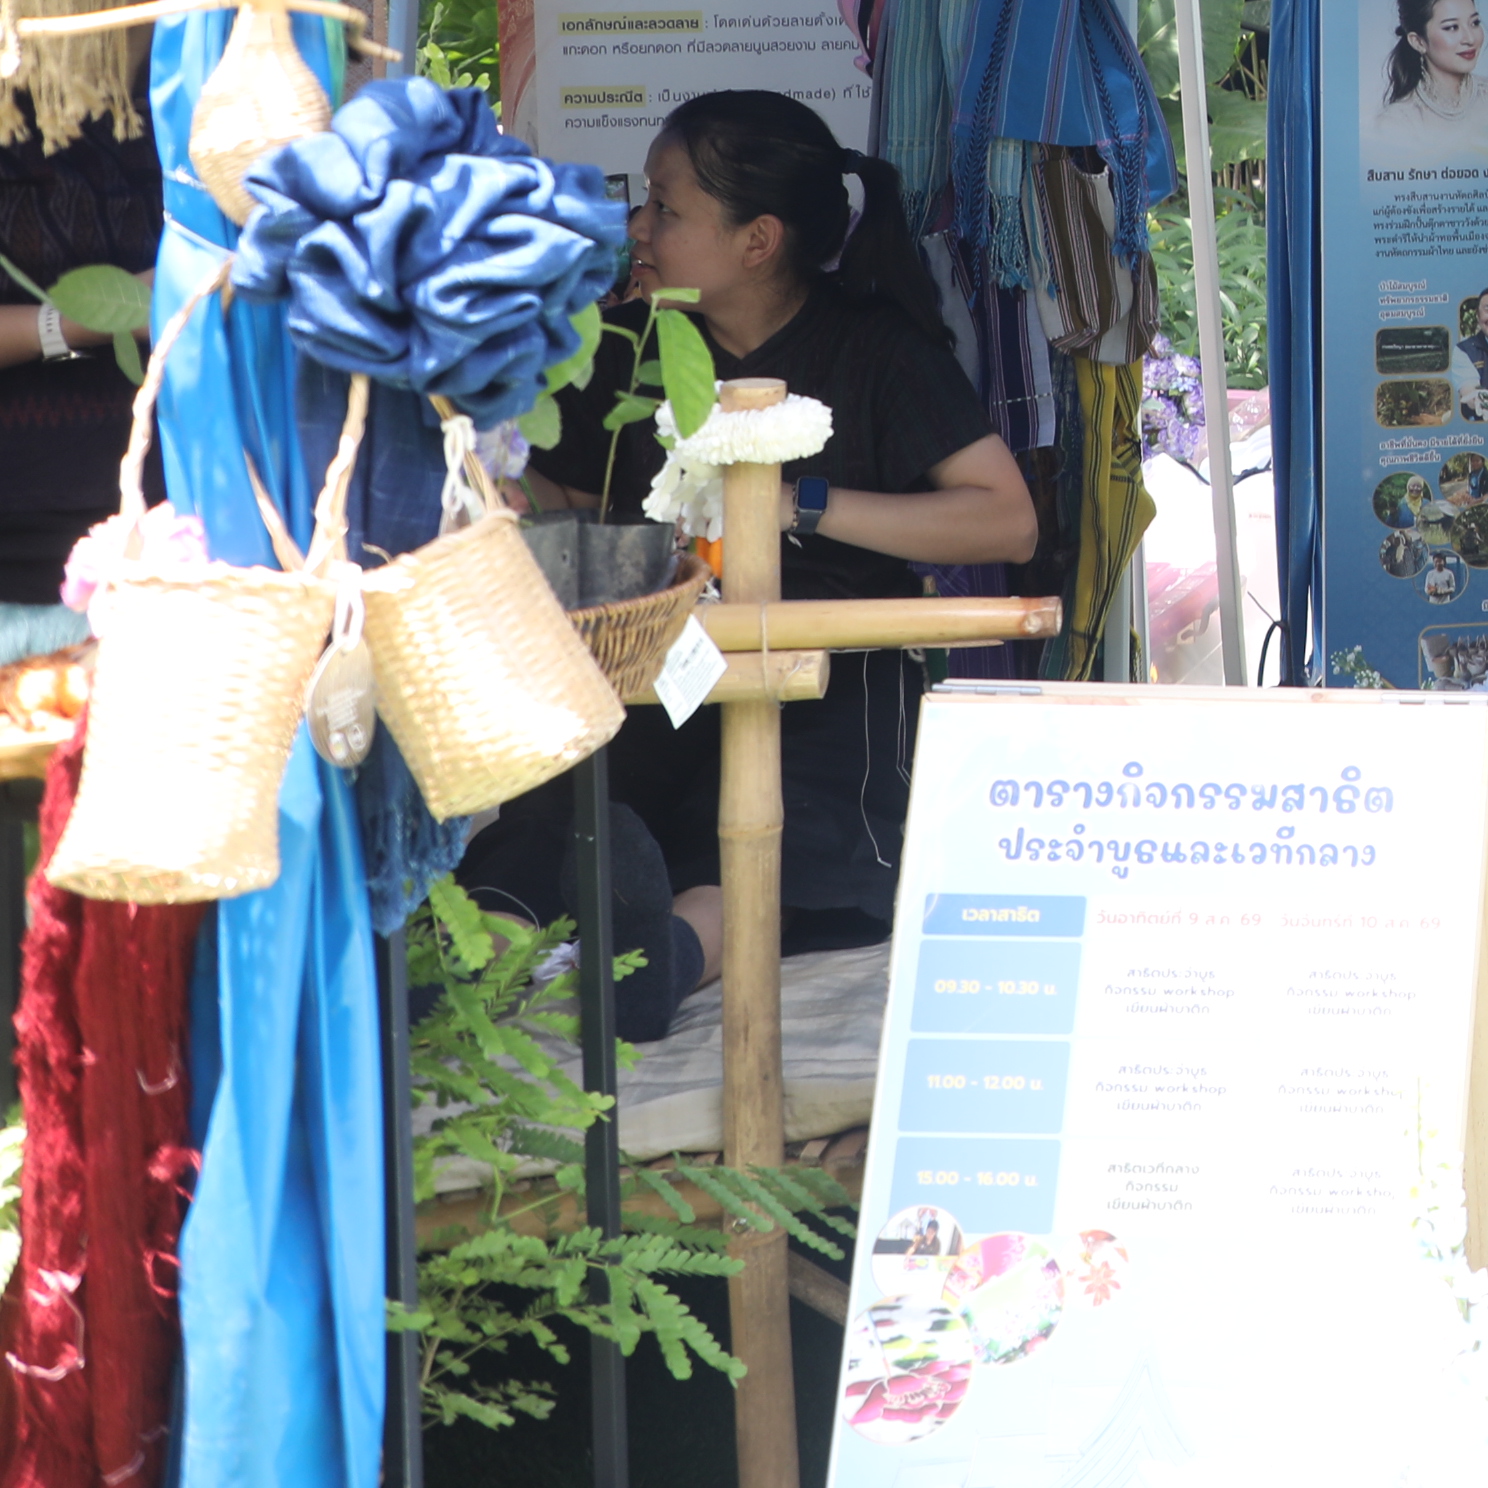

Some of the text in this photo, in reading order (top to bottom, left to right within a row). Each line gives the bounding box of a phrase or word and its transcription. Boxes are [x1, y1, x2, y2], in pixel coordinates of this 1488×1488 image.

[562, 14, 699, 31] เอกลักษณ์และลวดลาย
[563, 37, 816, 55] แกะดอก หรือยกดอก ที่มีลวดลายนูนสวยงาม
[565, 89, 643, 104] ความประณีต
[1367, 169, 1404, 182] สืบสาน
[1408, 168, 1437, 180] รักษา
[1441, 166, 1479, 180] ต่อยอด
[989, 761, 1394, 814] ตารางกิจกรรมสาธิต
[999, 823, 1375, 879] ประจำบูธและเวทีกลาง
[962, 905, 1040, 924] เวลาสาธิต
[1097, 907, 1261, 926] วันอาทิตย์ที่ 9 สค 69
[1361, 916, 1377, 929] 10
[1420, 917, 1440, 929] 69
[934, 977, 1058, 998] 09.30 10.30 น.
[1163, 984, 1235, 999] workshop
[1345, 986, 1417, 1001] workshop
[928, 1074, 1044, 1092] 11.00 12.00 น.
[1154, 1080, 1227, 1098] workshop
[918, 1170, 1039, 1188] 15.00 16.00 น.
